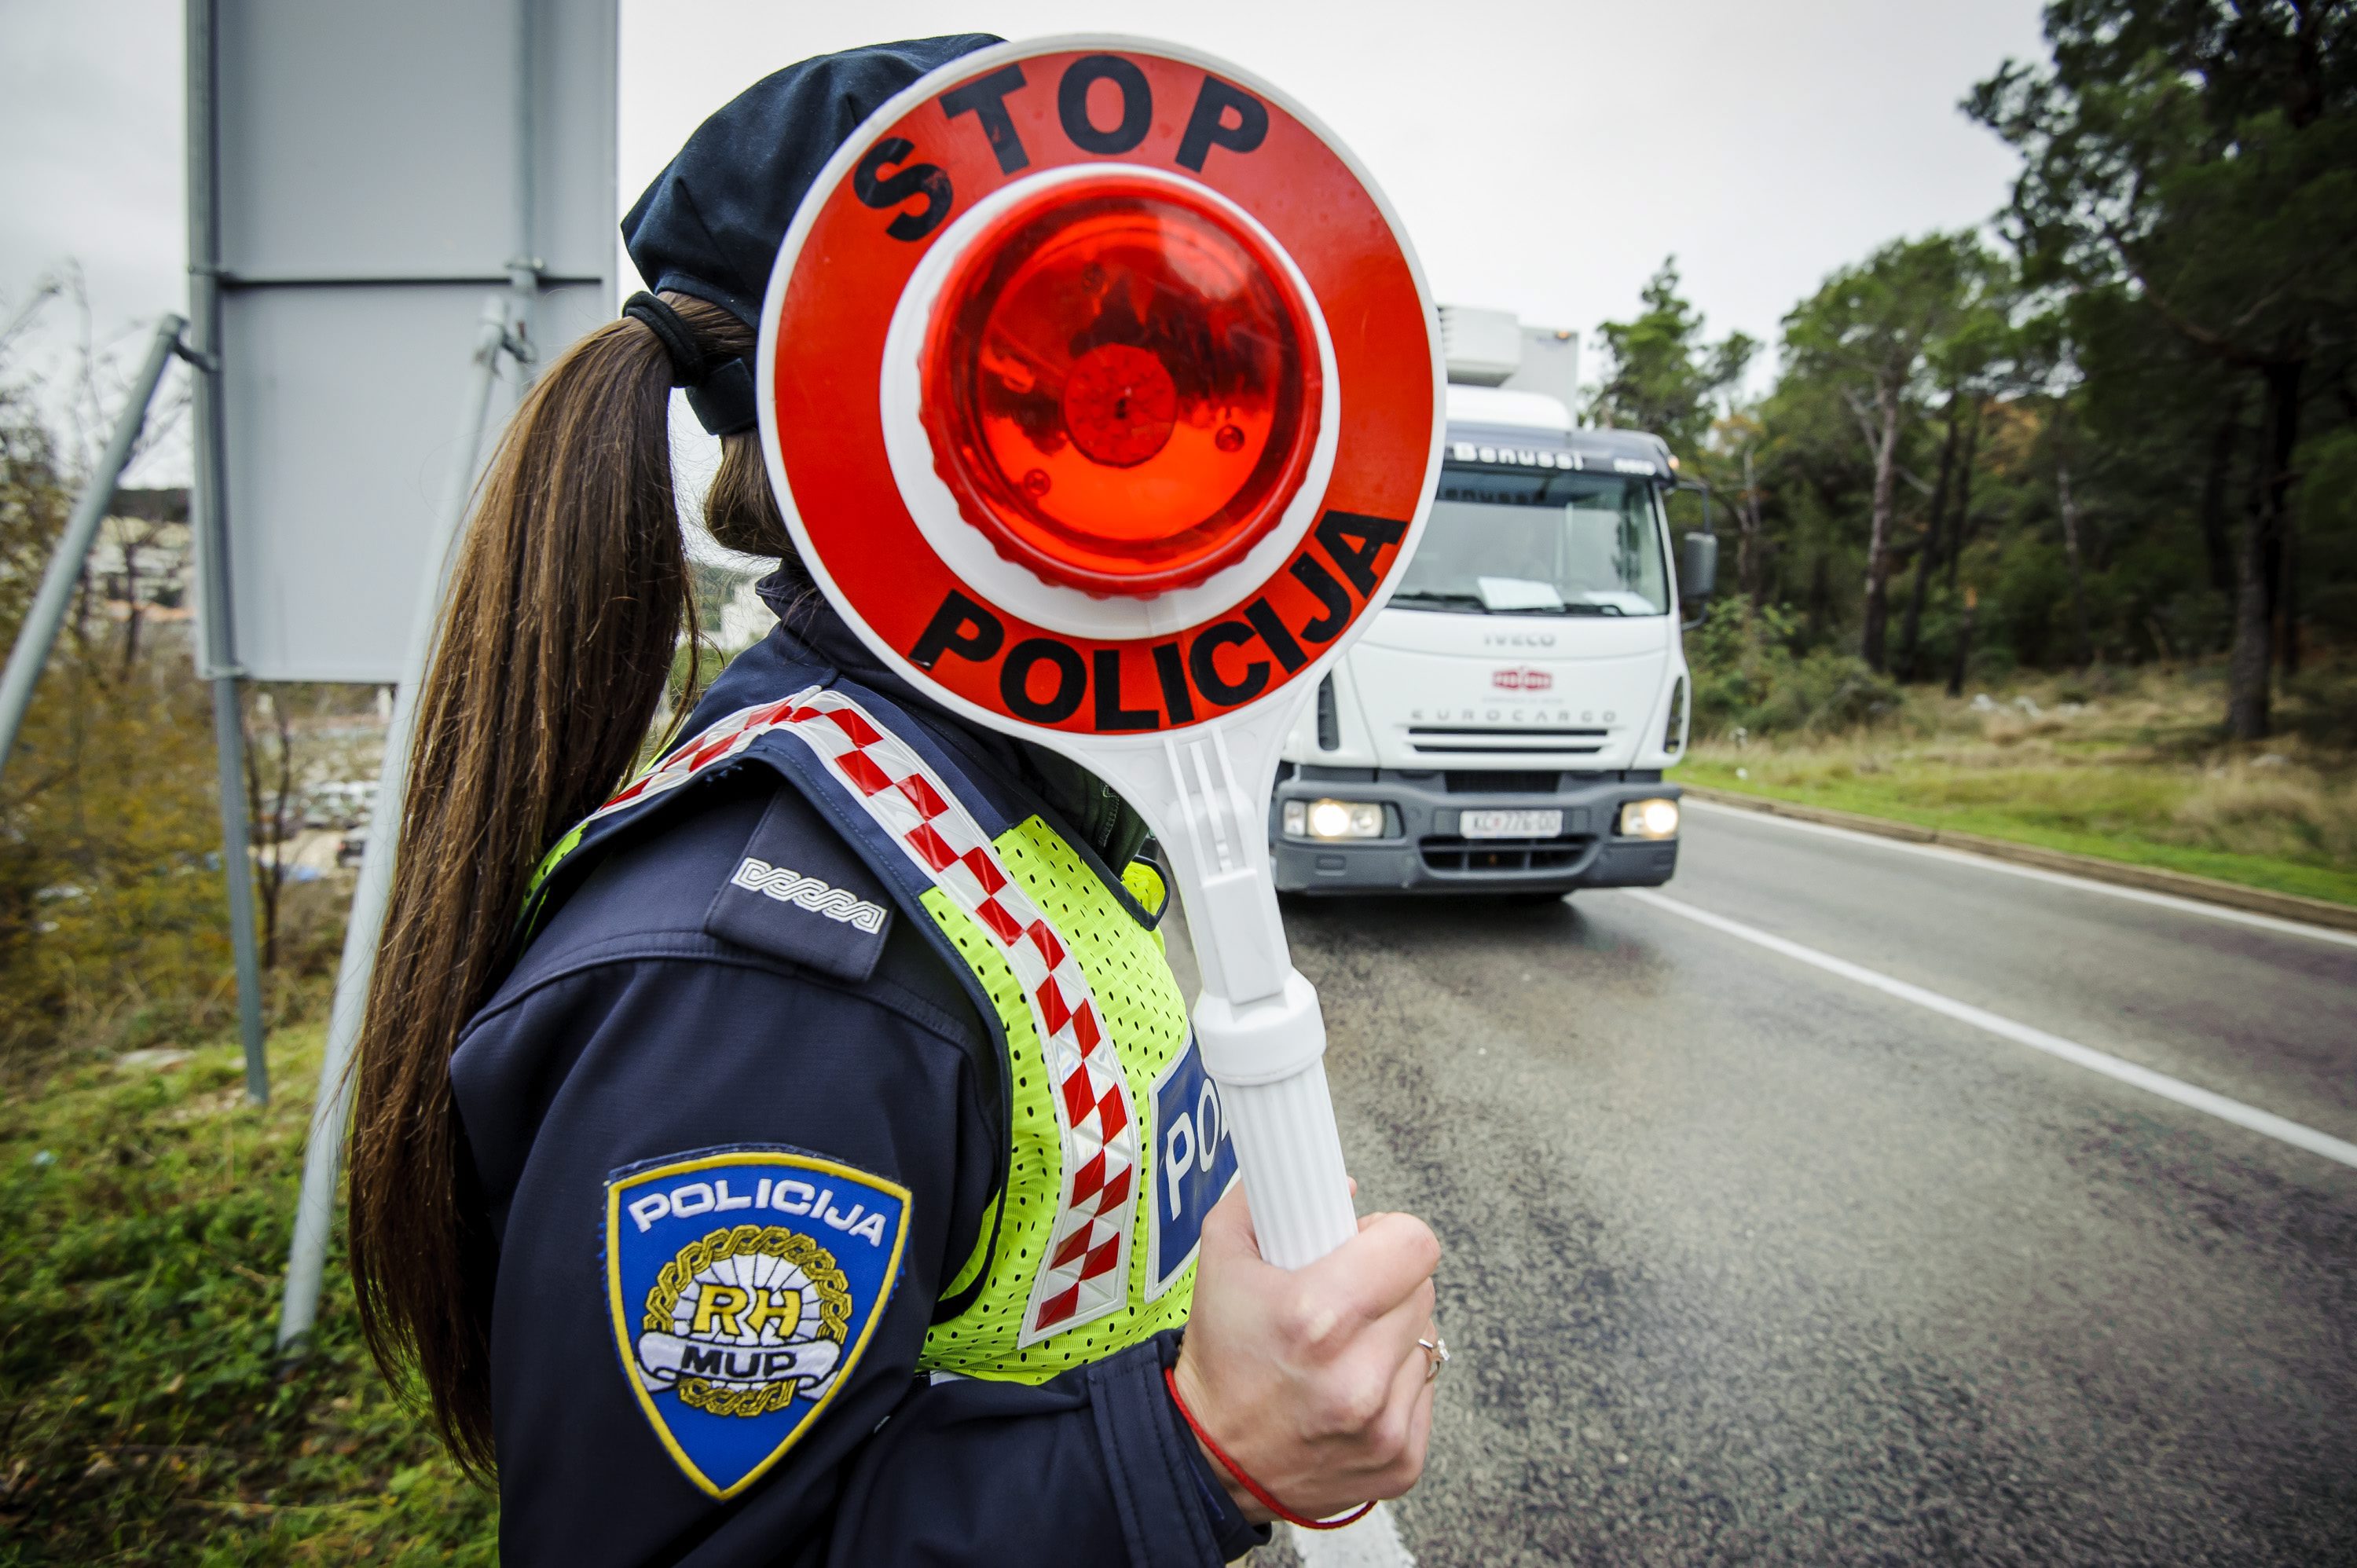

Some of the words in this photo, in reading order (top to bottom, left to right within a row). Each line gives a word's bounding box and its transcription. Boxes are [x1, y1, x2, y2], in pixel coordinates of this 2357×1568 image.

[853, 55, 1270, 242] STOP
[1453, 441, 1584, 471] Benussi
[909, 509, 1409, 733] POLICIJA
[1409, 709, 1617, 723] EUROCARGO
[629, 1178, 886, 1247] POLICIJA
[693, 1283, 802, 1337] RH
[680, 1345, 798, 1378] MUP
